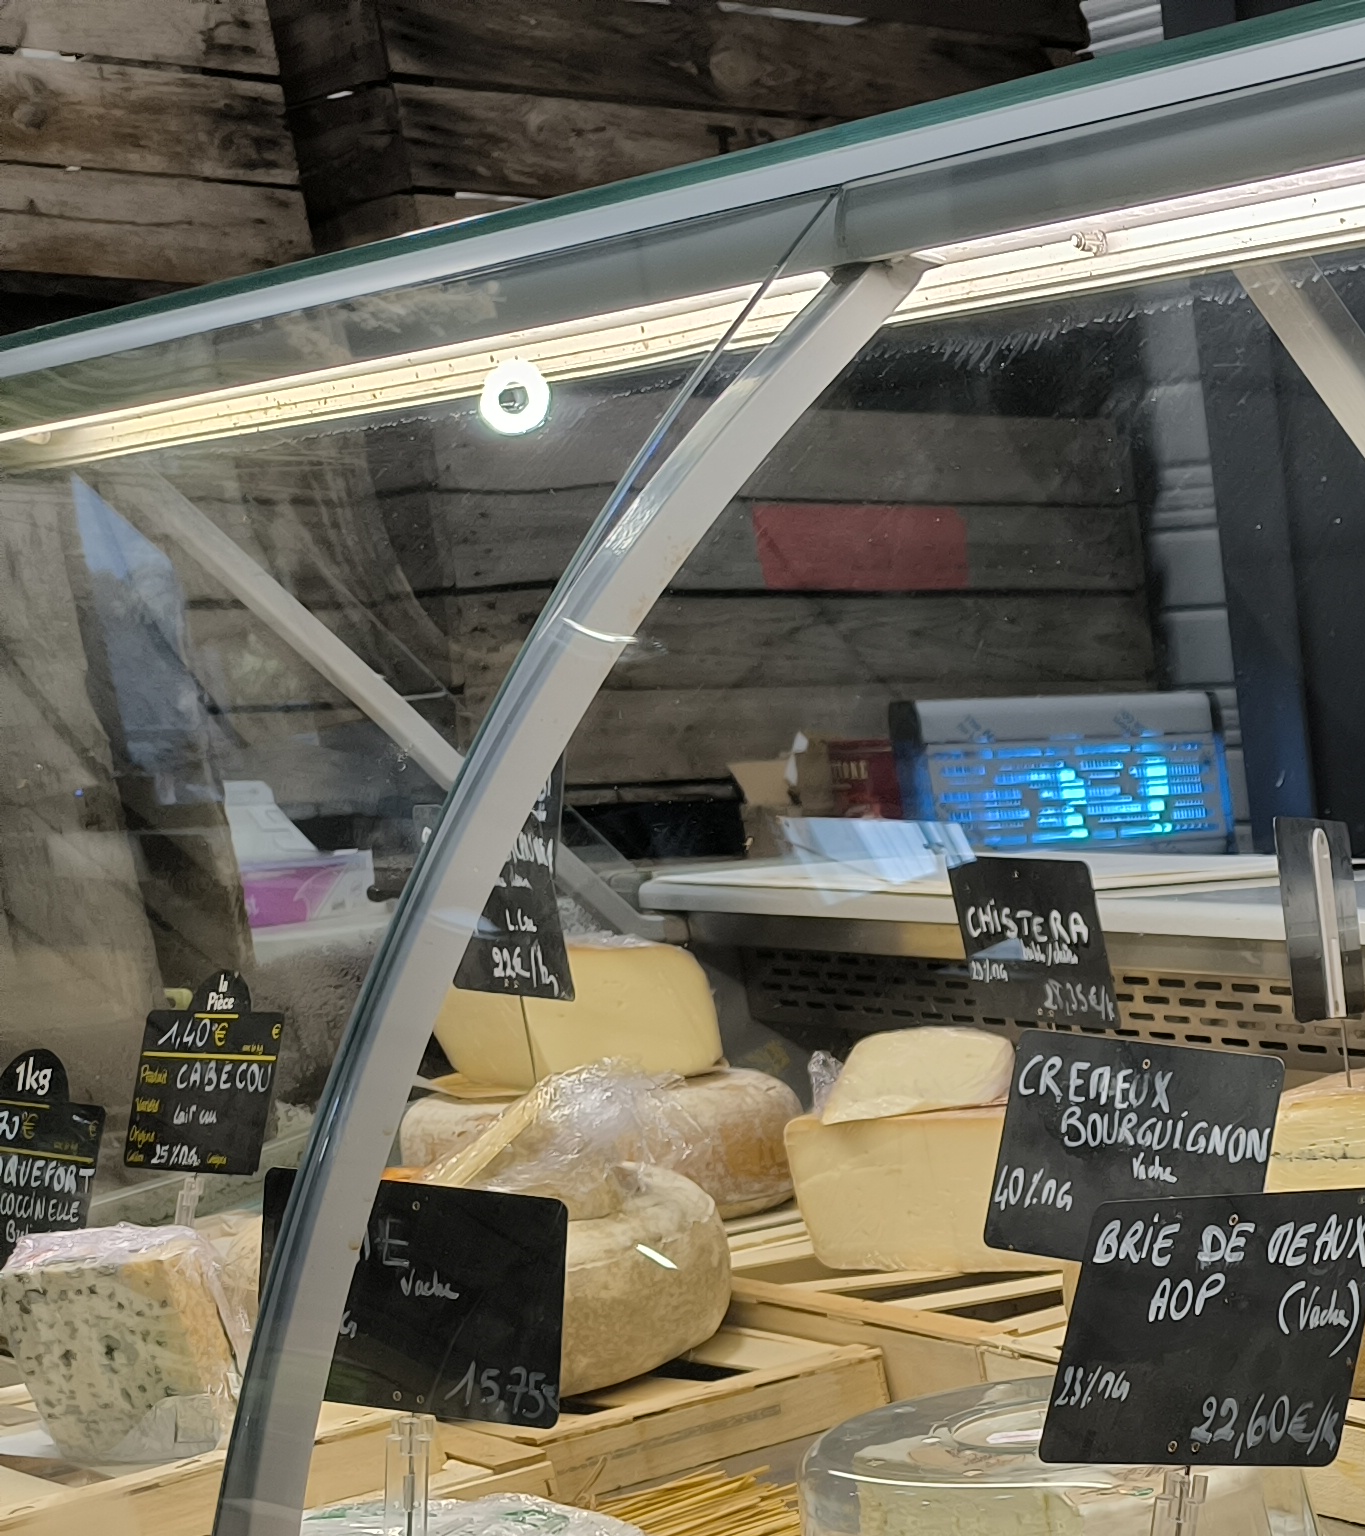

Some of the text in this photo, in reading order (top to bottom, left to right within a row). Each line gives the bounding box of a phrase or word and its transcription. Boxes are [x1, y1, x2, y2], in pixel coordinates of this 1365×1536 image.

[206, 991, 235, 1012] Pièce
[15, 1056, 53, 1096] 1kg
[1017, 1054, 1174, 1114] CREMEUX
[1060, 1105, 1272, 1164] BOURGUIGNON
[1132, 1151, 1179, 1184] Vache
[1092, 1212, 1182, 1268] BRIE
[1197, 1222, 1256, 1264] DE
[400, 1267, 460, 1300] Vache
[1147, 1271, 1227, 1323] AOP
